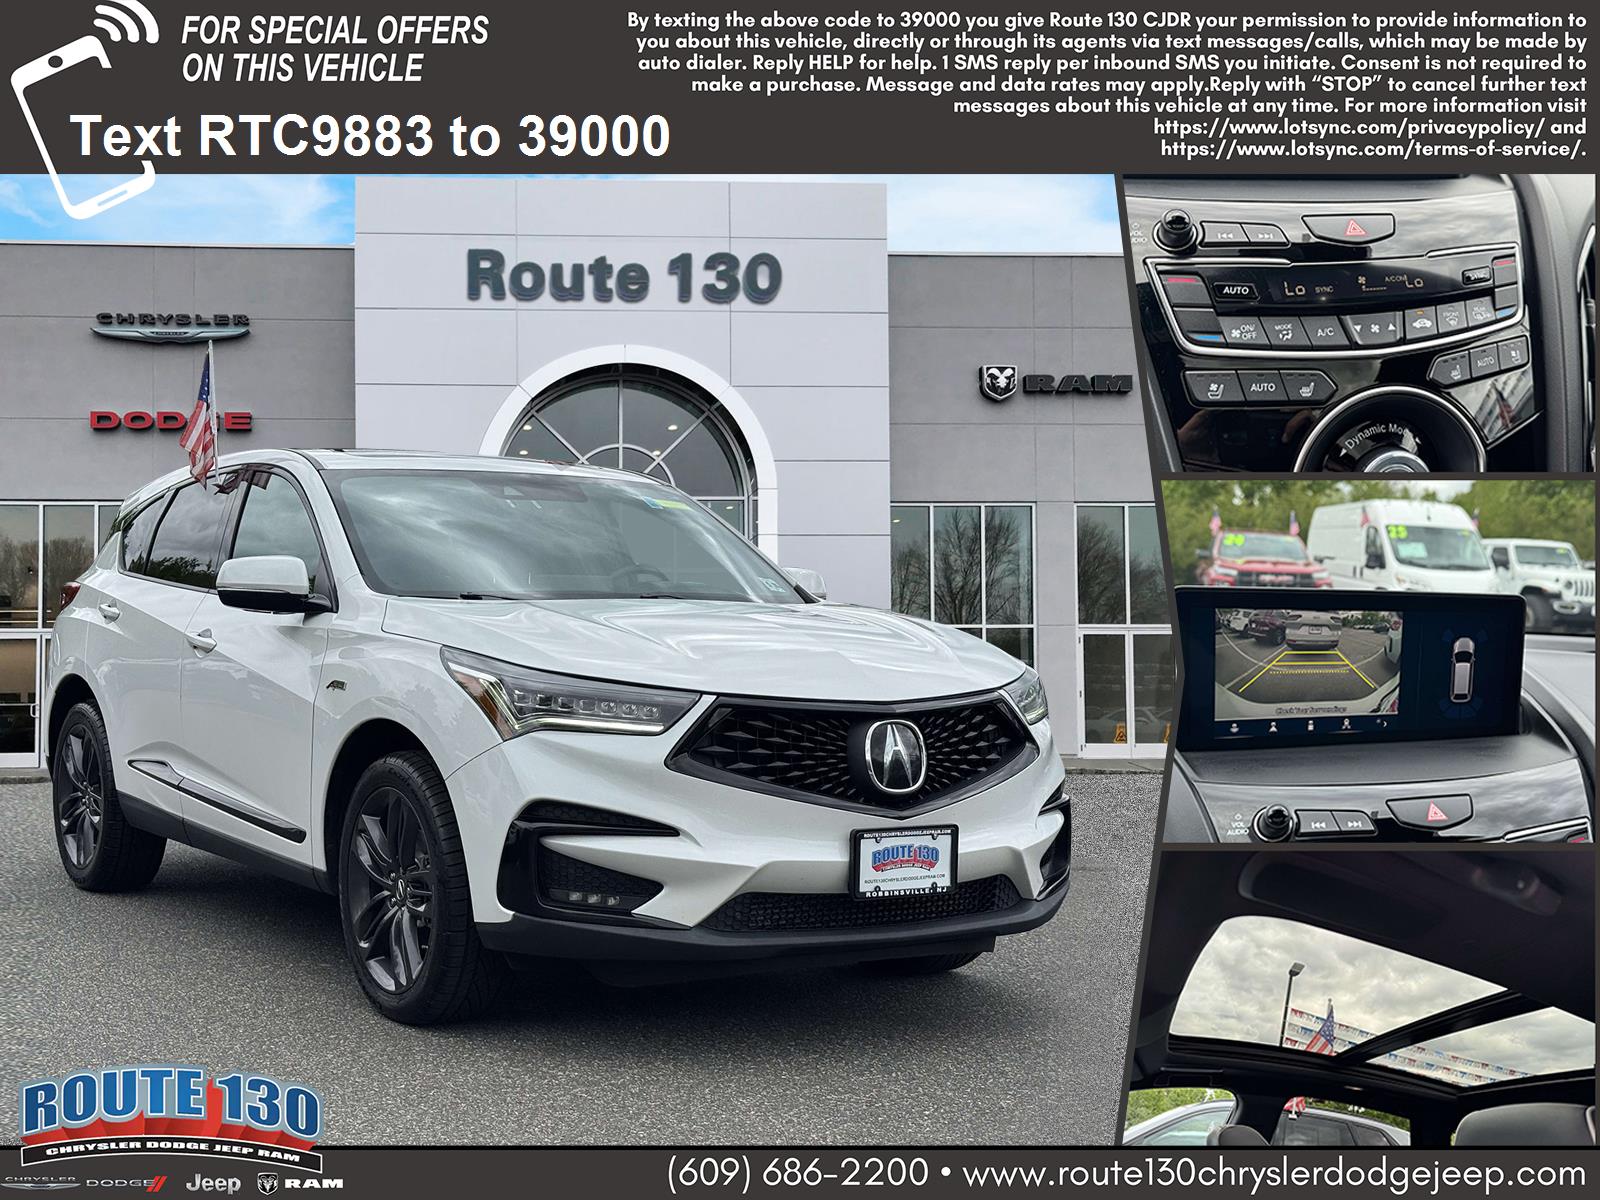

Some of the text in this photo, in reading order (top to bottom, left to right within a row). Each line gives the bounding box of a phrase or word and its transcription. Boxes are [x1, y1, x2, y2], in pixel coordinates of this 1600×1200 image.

[467, 249, 782, 304] Route 130
[1223, 286, 1249, 295] AUTO
[1315, 285, 1334, 293] SYNC
[96, 312, 249, 325] CHRYSLER
[1242, 332, 1257, 340] OFF
[1317, 327, 1334, 337] A/C
[1477, 356, 1495, 367] AUTO
[1023, 375, 1133, 394] RAM
[1250, 383, 1276, 392] AUTO
[90, 411, 252, 431] DODE
[1345, 424, 1386, 450] Dynamic
[872, 844, 914, 867] ROUTE
[915, 844, 939, 863] 130
[865, 887, 934, 898] ROBBINSVILLE,
